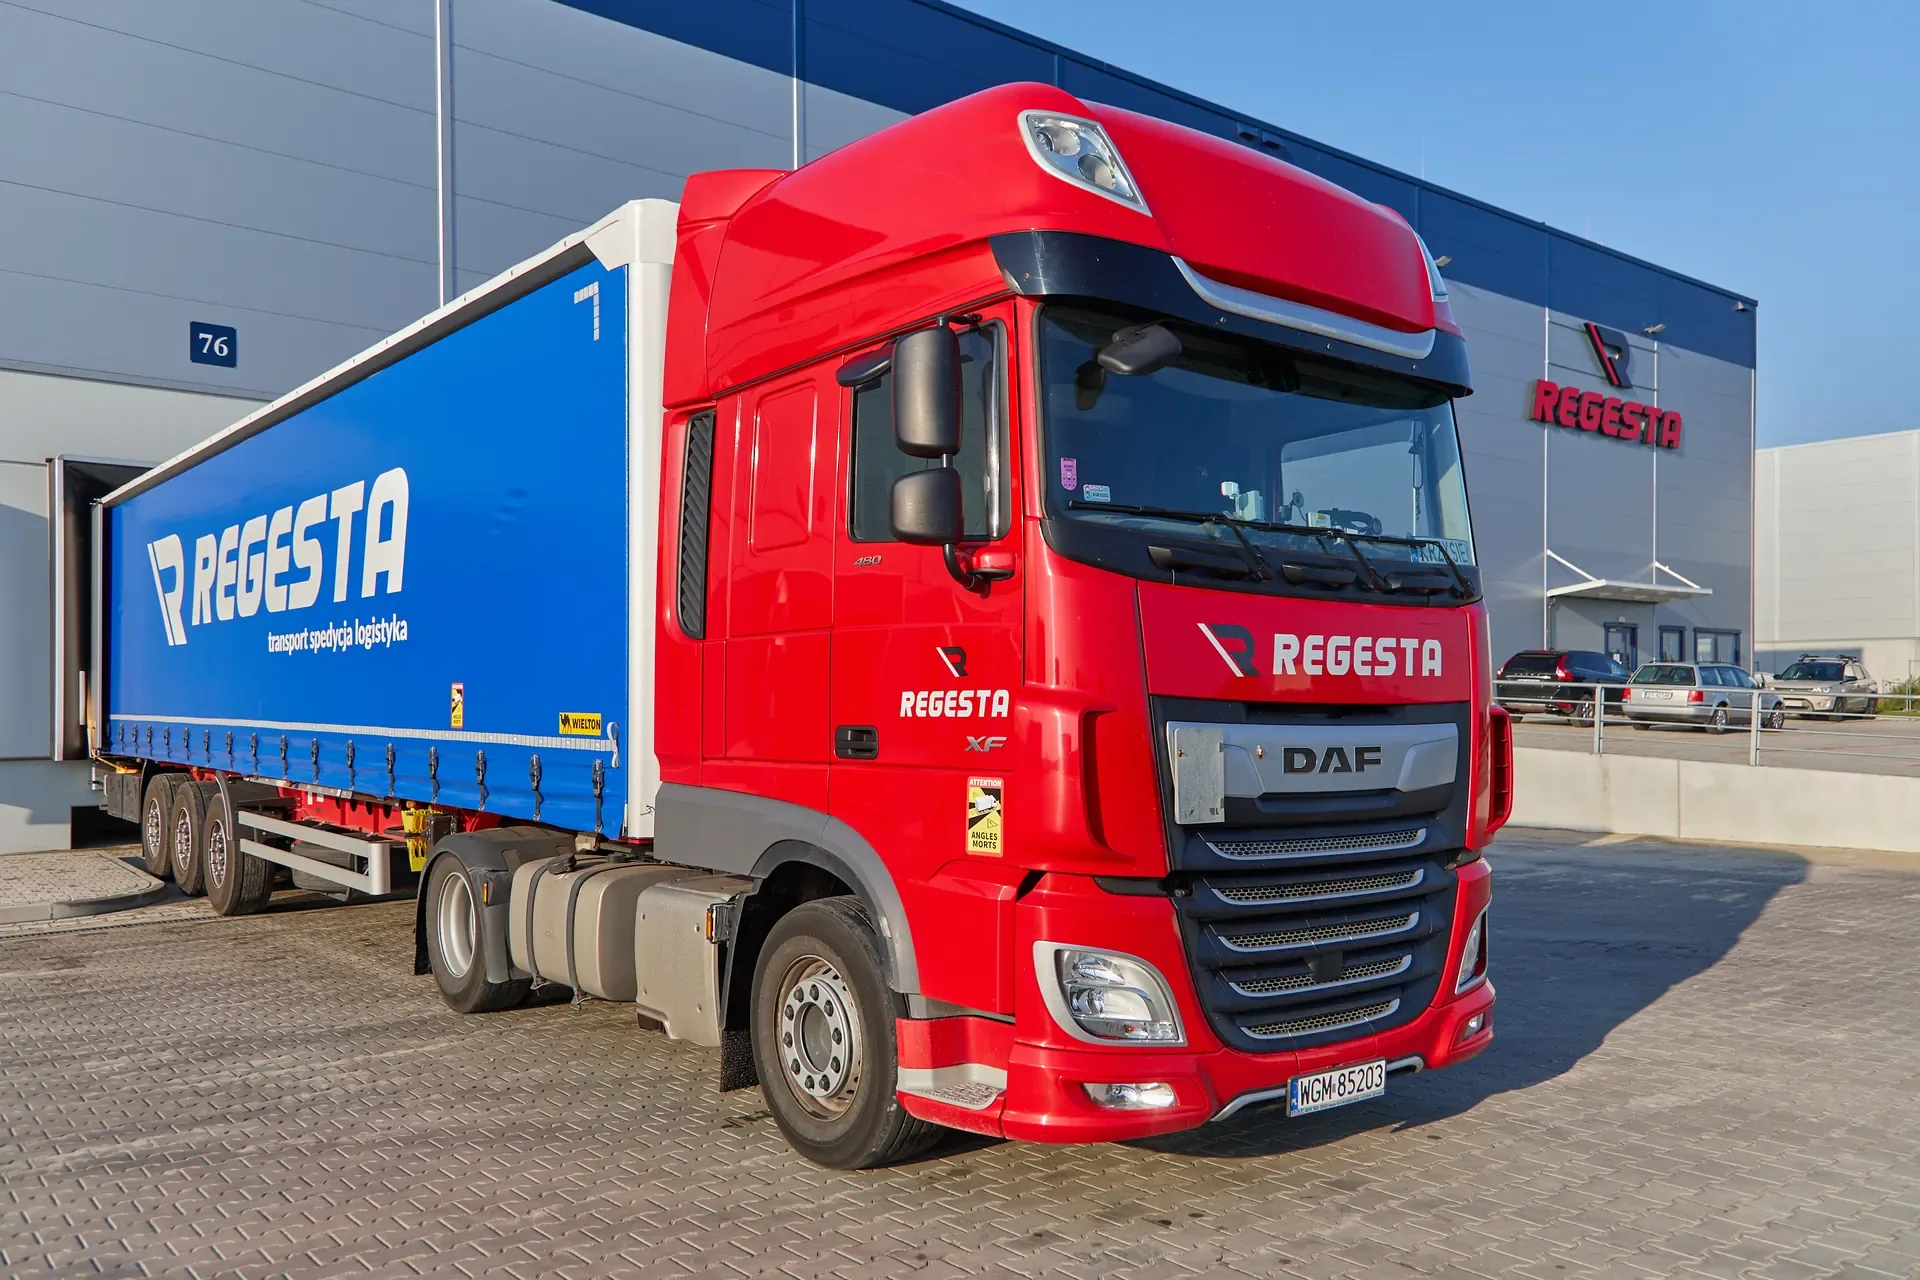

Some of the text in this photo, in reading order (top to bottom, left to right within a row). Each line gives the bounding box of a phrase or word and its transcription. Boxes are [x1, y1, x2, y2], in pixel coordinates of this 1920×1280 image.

[198, 332, 229, 357] 76
[1530, 378, 1682, 449] REGESTA
[191, 466, 409, 626] REGESTA
[853, 555, 883, 567] 480
[268, 613, 408, 656] transport spedycja logistyka
[1272, 633, 1442, 677] REGESTA
[899, 689, 1010, 718] REGESTA
[571, 718, 601, 730] WIELTON
[964, 735, 1008, 752] XF
[1281, 745, 1382, 774] DAF
[968, 778, 1002, 788] ATTENTION
[971, 831, 998, 841] ANGLES
[972, 840, 997, 850] MORTS
[1300, 1075, 1333, 1106] WGM
[1337, 1064, 1383, 1097] 85203
